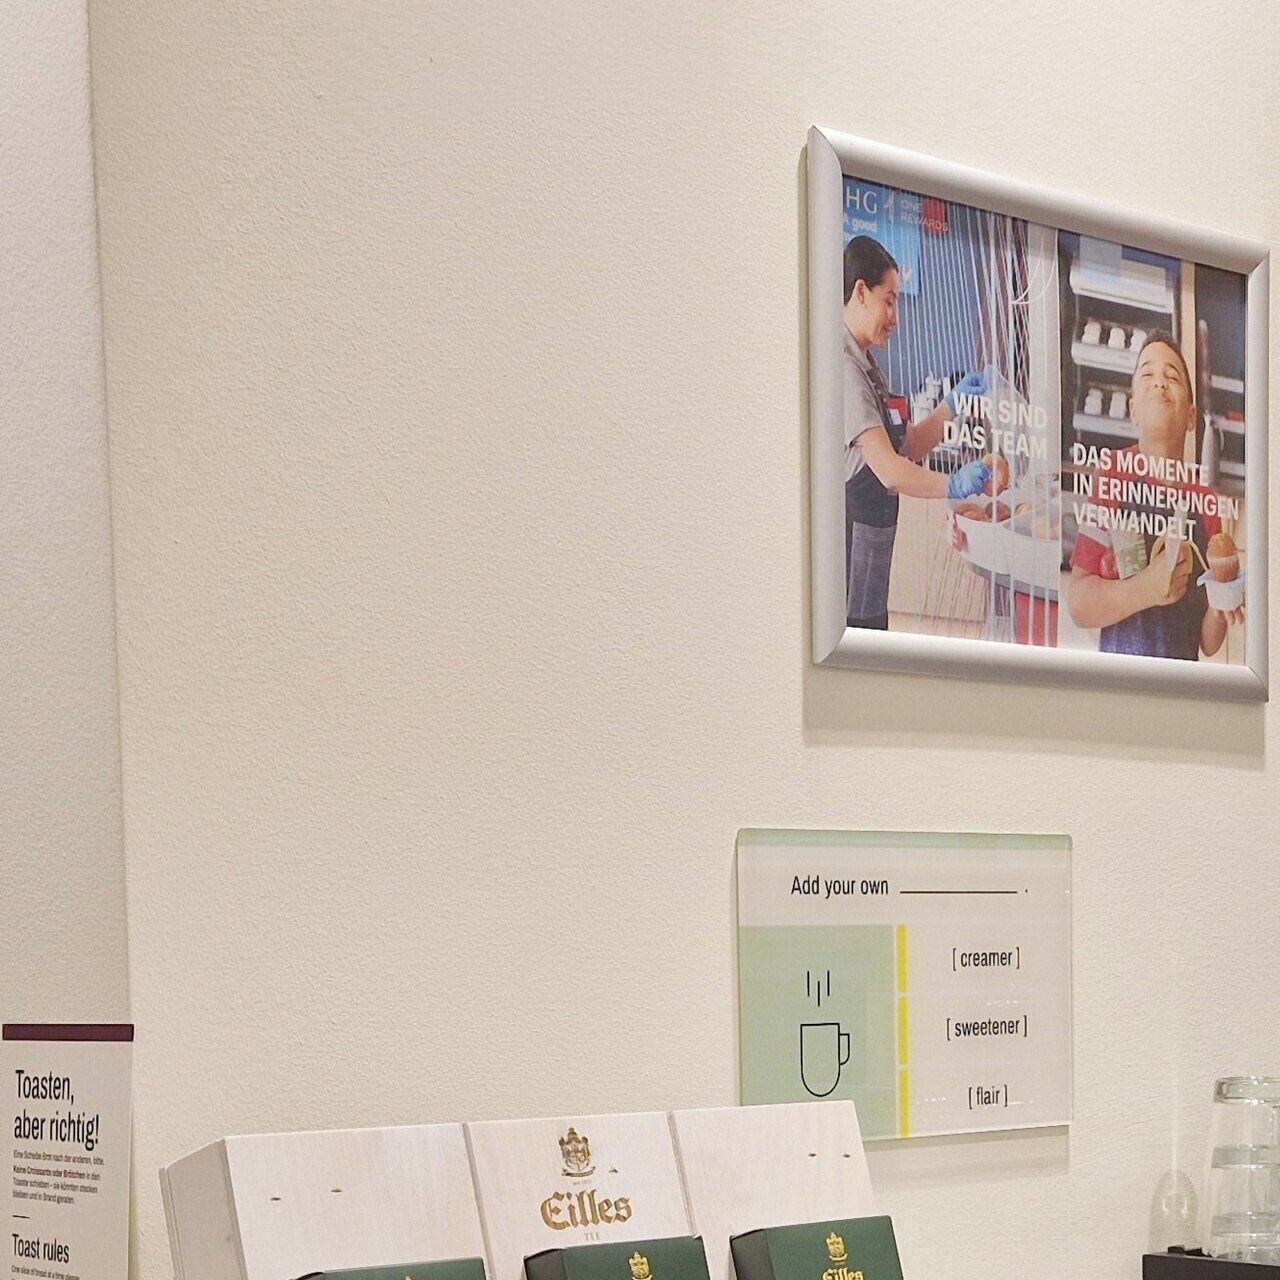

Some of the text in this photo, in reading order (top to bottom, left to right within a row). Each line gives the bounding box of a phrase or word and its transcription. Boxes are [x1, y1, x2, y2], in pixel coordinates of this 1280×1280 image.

[846, 186, 877, 214] HG
[953, 390, 1047, 426] WIR SIND
[943, 422, 1047, 460] DAS TEAM
[1073, 443, 1209, 486] DAS MOMENTE
[1073, 472, 1239, 521] IN ERINNERUNGEN
[1073, 502, 1196, 541] VERWANDELT
[791, 875, 889, 899] Add your own
[15, 1069, 74, 1106] Toasten,
[14, 1109, 99, 1151] aber richtig!
[12, 1233, 70, 1264] Toast rules
